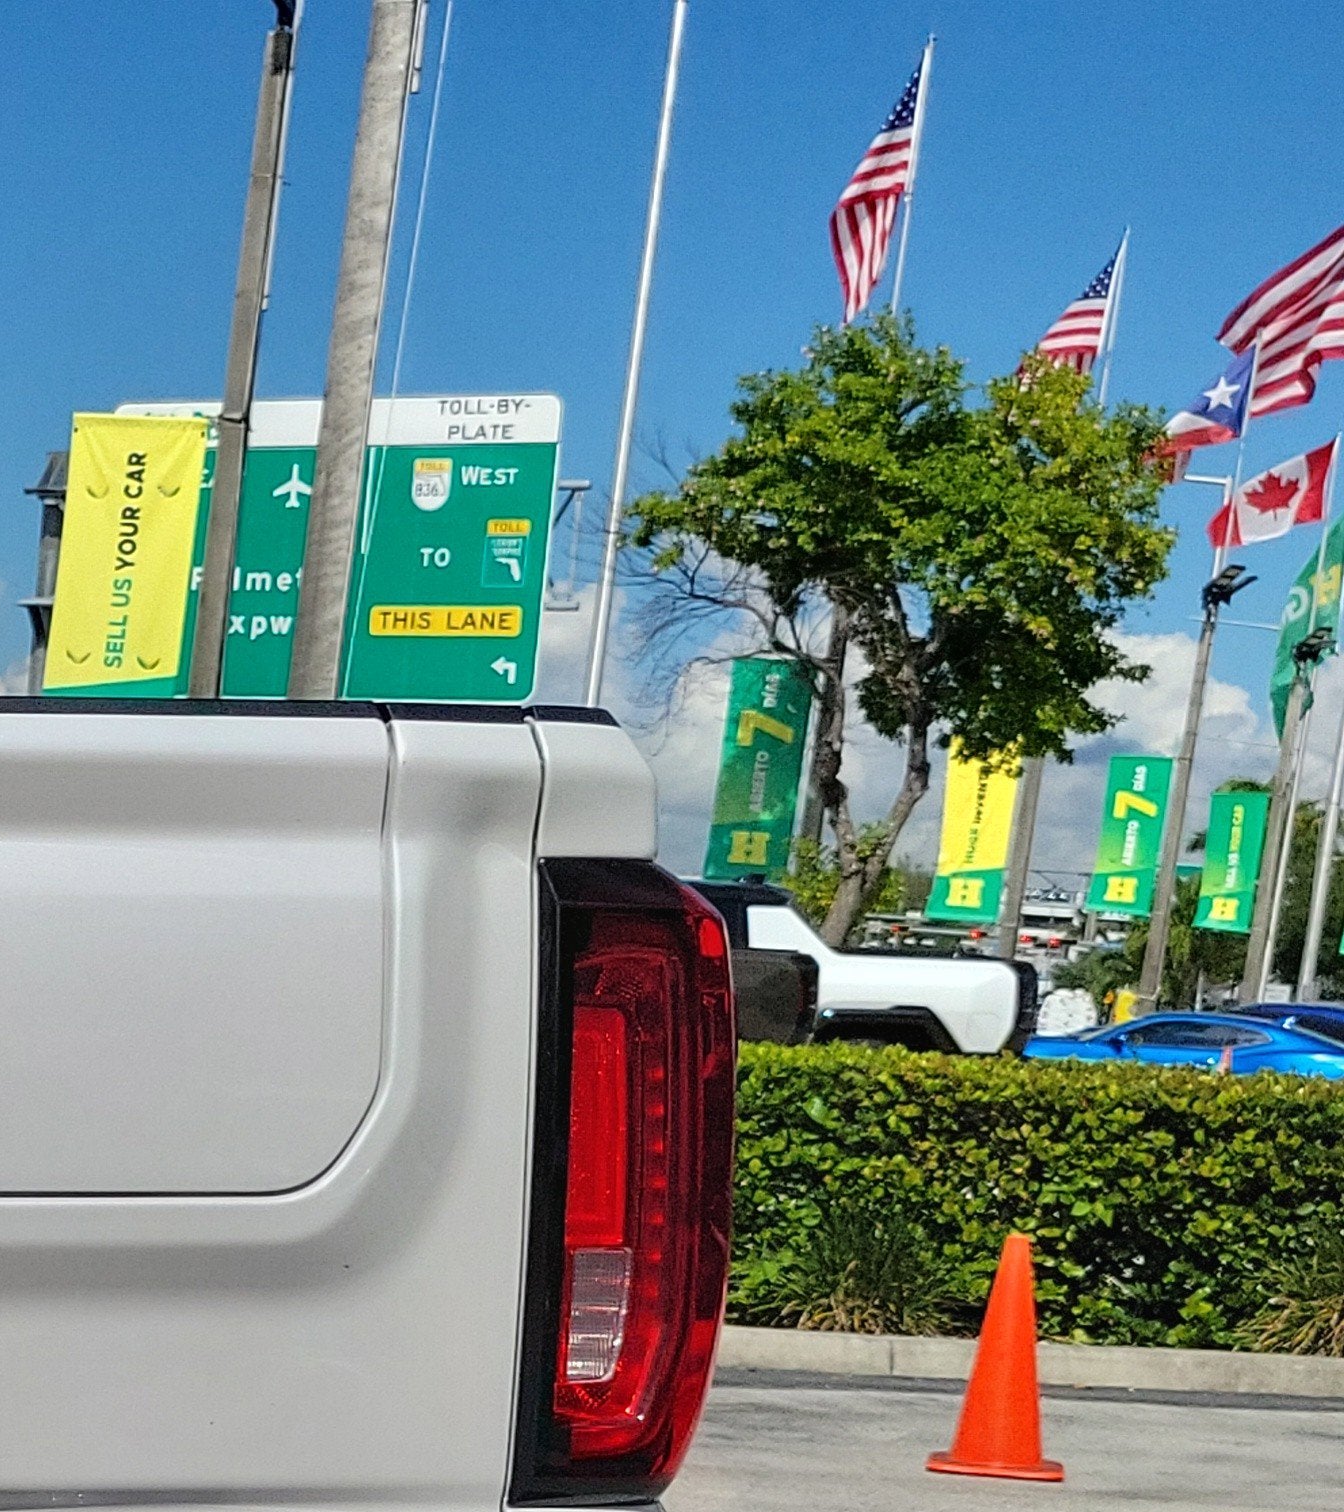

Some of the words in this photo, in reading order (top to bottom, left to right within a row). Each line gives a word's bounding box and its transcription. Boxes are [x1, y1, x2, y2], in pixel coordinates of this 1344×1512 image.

[438, 399, 531, 415] TOLL-BY-
[447, 424, 515, 440] PLATE
[123, 452, 148, 499] CAR
[461, 465, 519, 486] WEST
[115, 506, 142, 571] YOUR
[420, 547, 451, 567] TO
[110, 577, 133, 608] US
[379, 612, 432, 630] THIS
[446, 612, 512, 631] LANE
[103, 614, 129, 668] SELL
[736, 709, 794, 747] 7
[1113, 790, 1159, 818] 7
